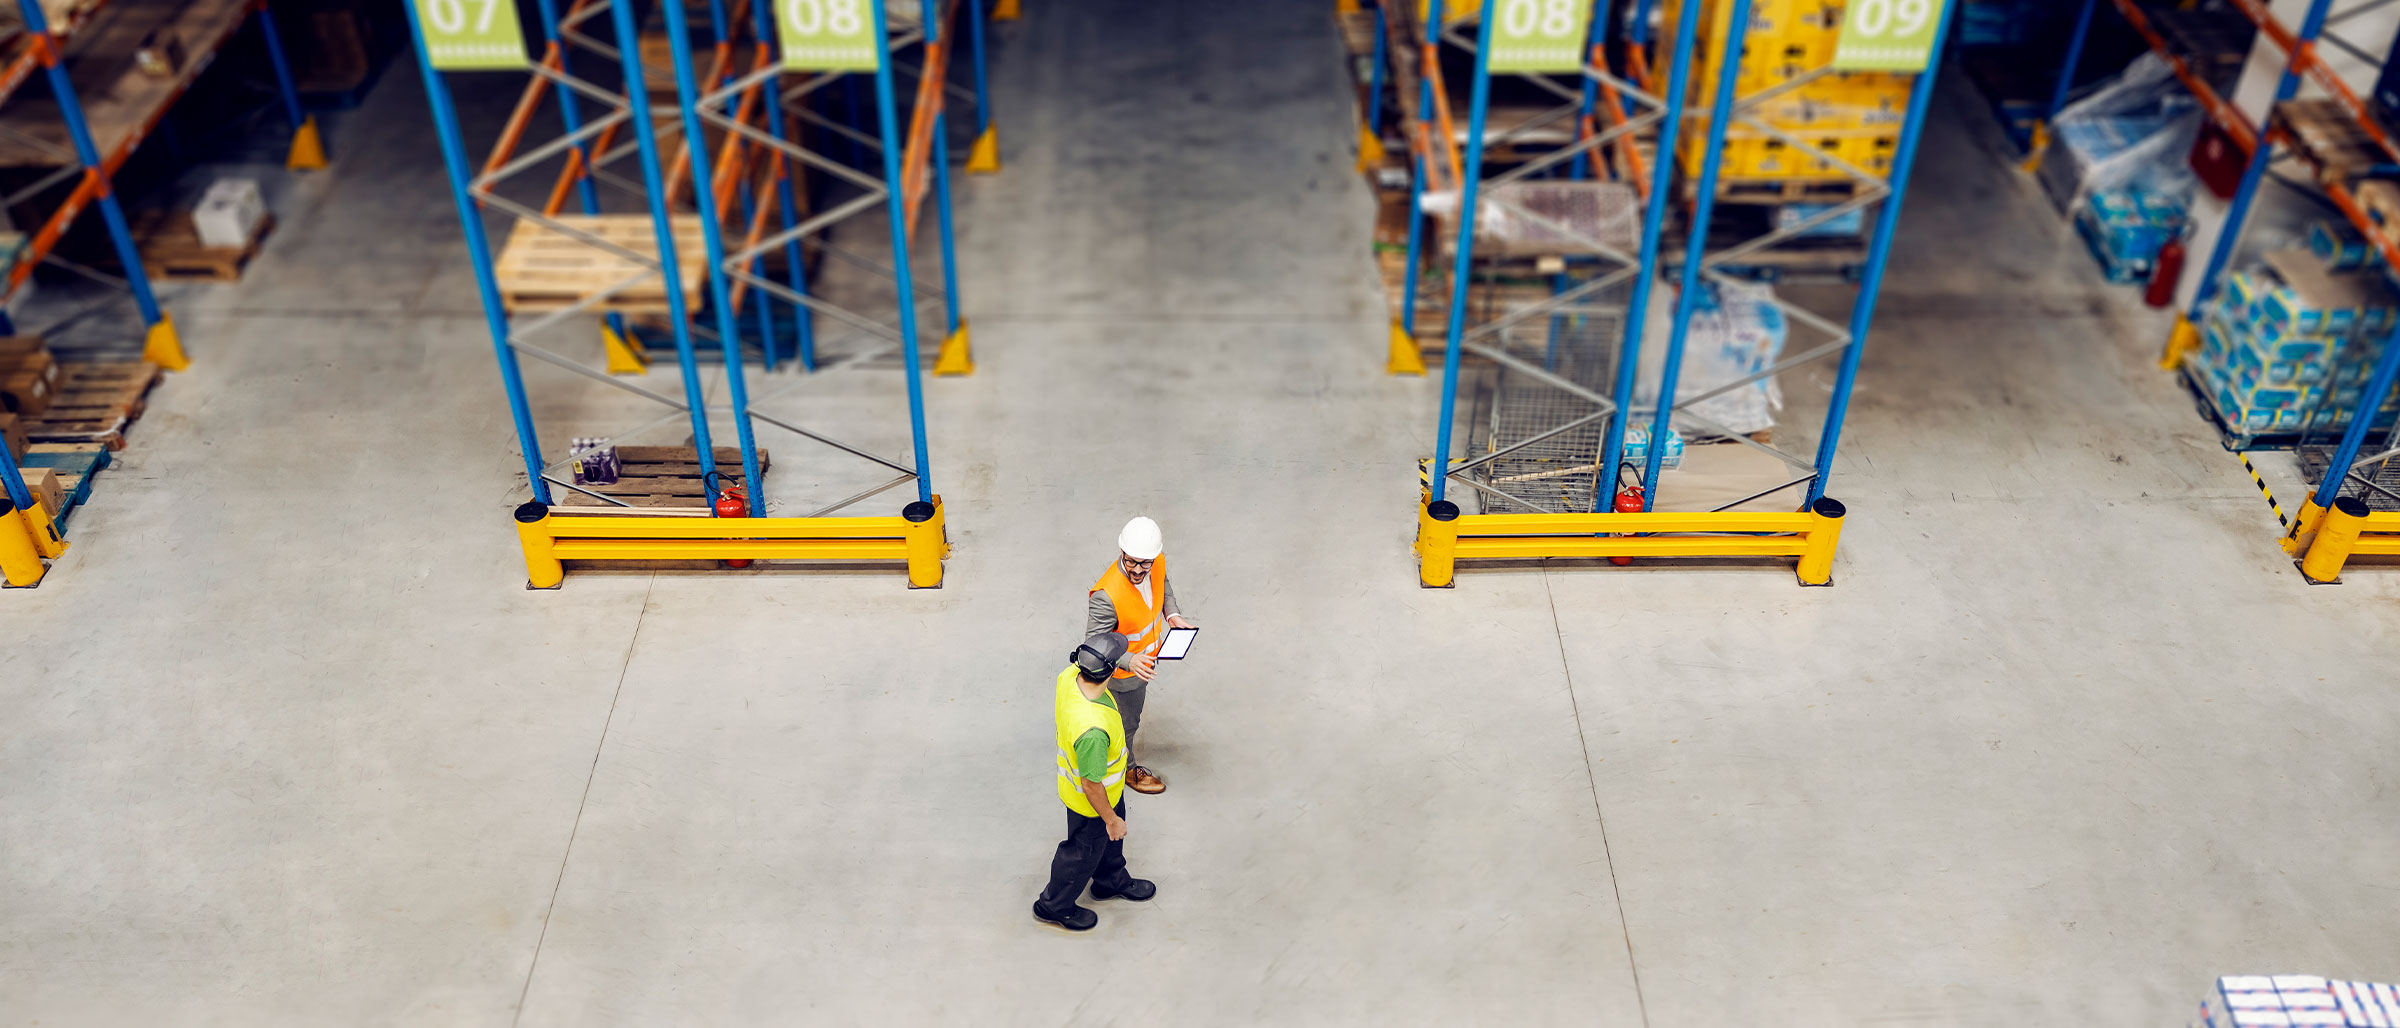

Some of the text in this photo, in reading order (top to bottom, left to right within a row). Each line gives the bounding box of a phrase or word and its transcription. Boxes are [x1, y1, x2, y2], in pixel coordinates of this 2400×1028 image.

[427, 0, 498, 34] 07
[789, 0, 860, 36] 08
[1504, 0, 1575, 37] 08
[1856, 0, 1930, 36] 09
